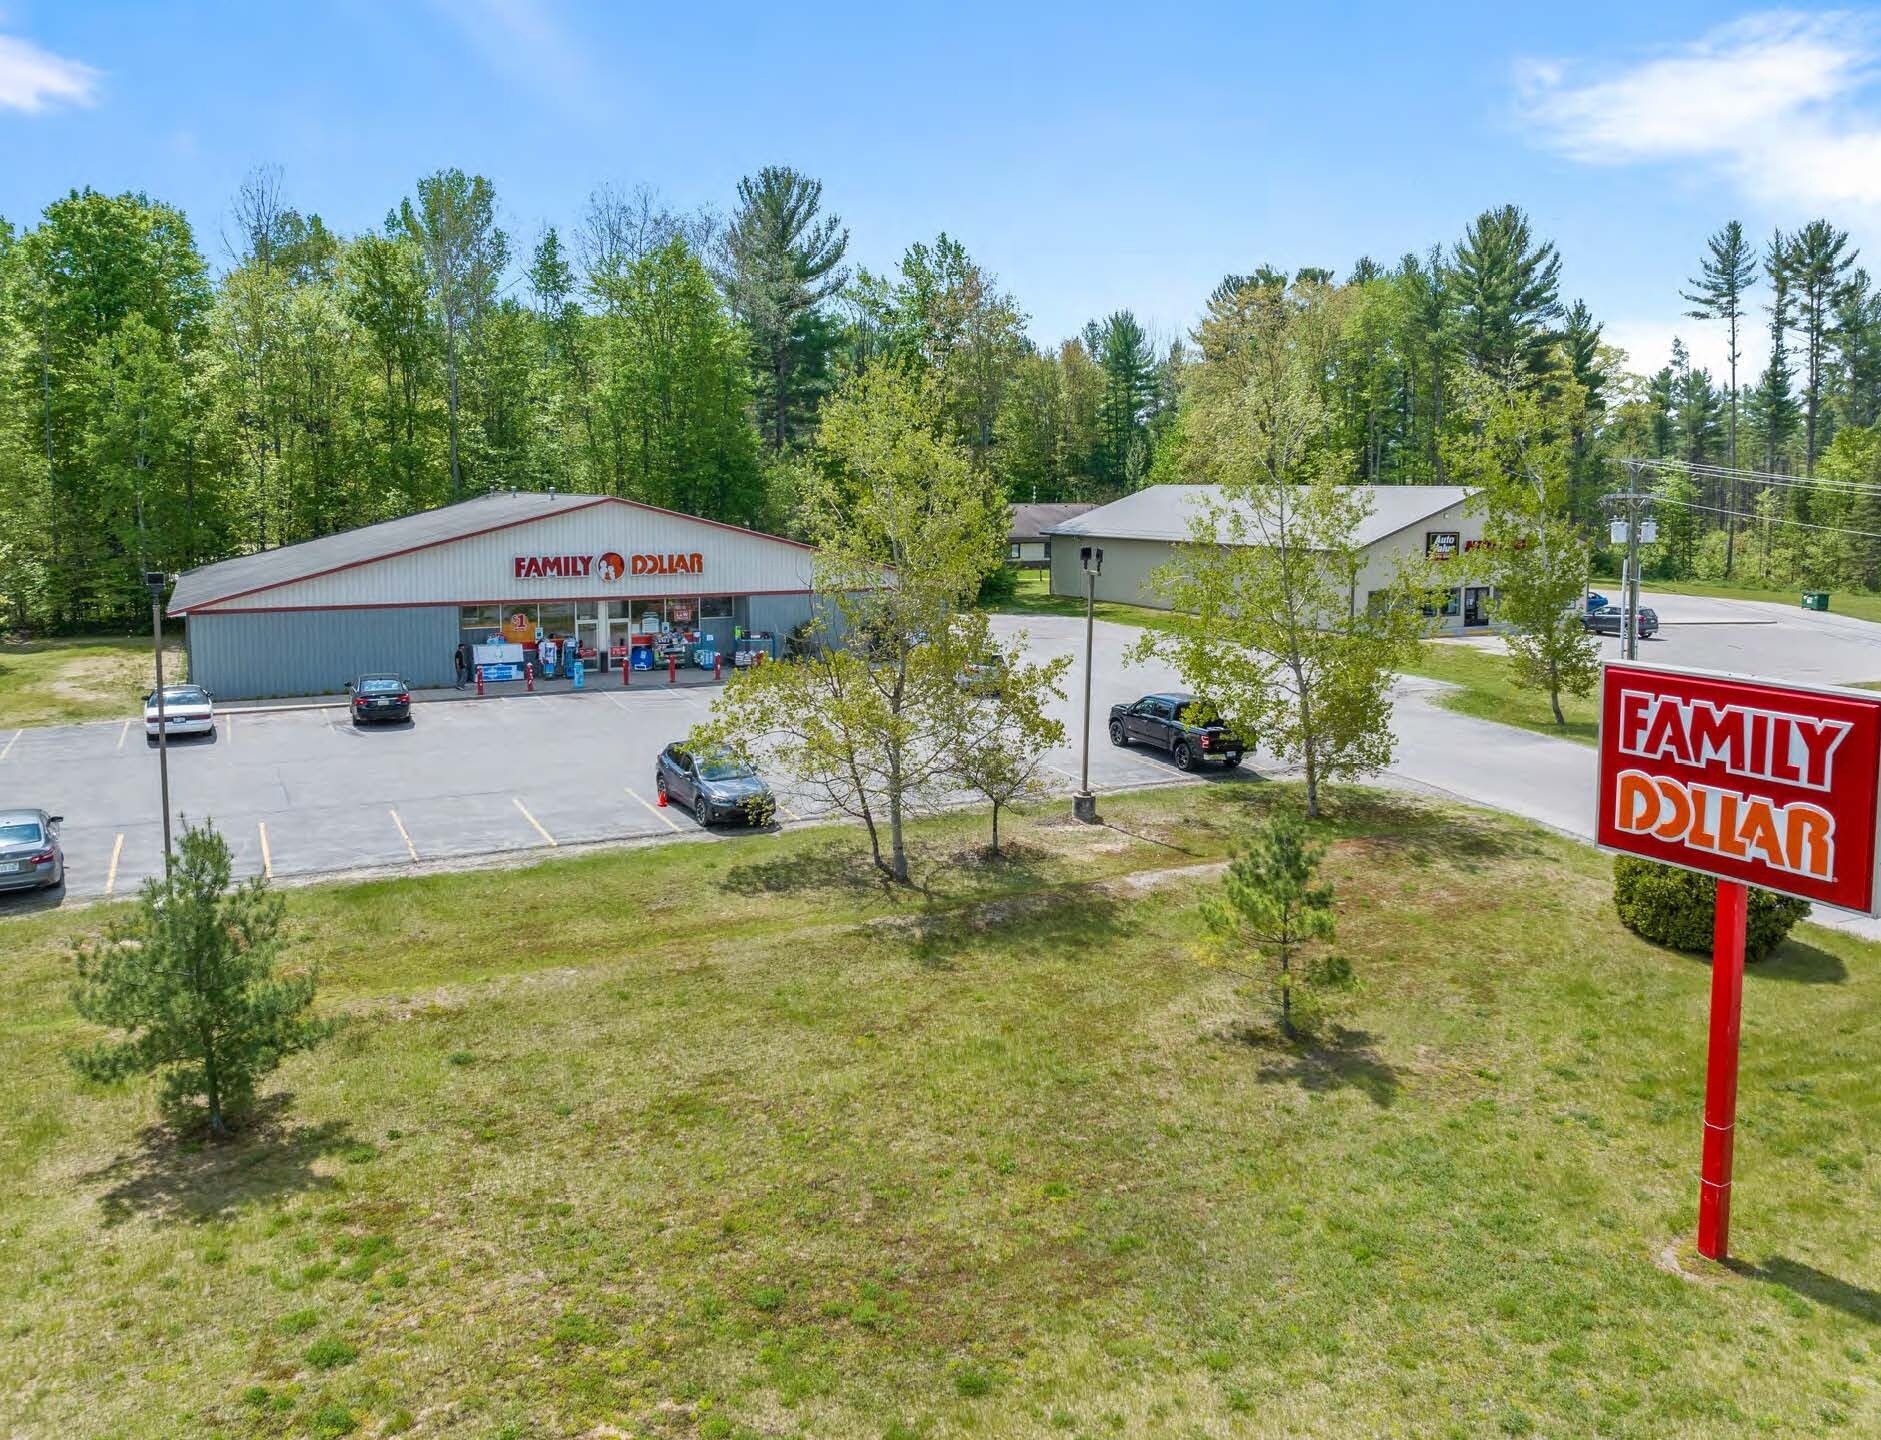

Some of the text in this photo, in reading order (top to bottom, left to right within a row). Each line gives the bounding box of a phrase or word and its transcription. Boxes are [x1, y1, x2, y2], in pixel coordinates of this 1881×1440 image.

[1434, 535, 1455, 544] Auto
[514, 552, 704, 577] FAMILY DOLLAR
[512, 614, 527, 628] $1
[1620, 690, 1852, 791] FAMILY
[1616, 771, 1833, 880] DOLLAR
